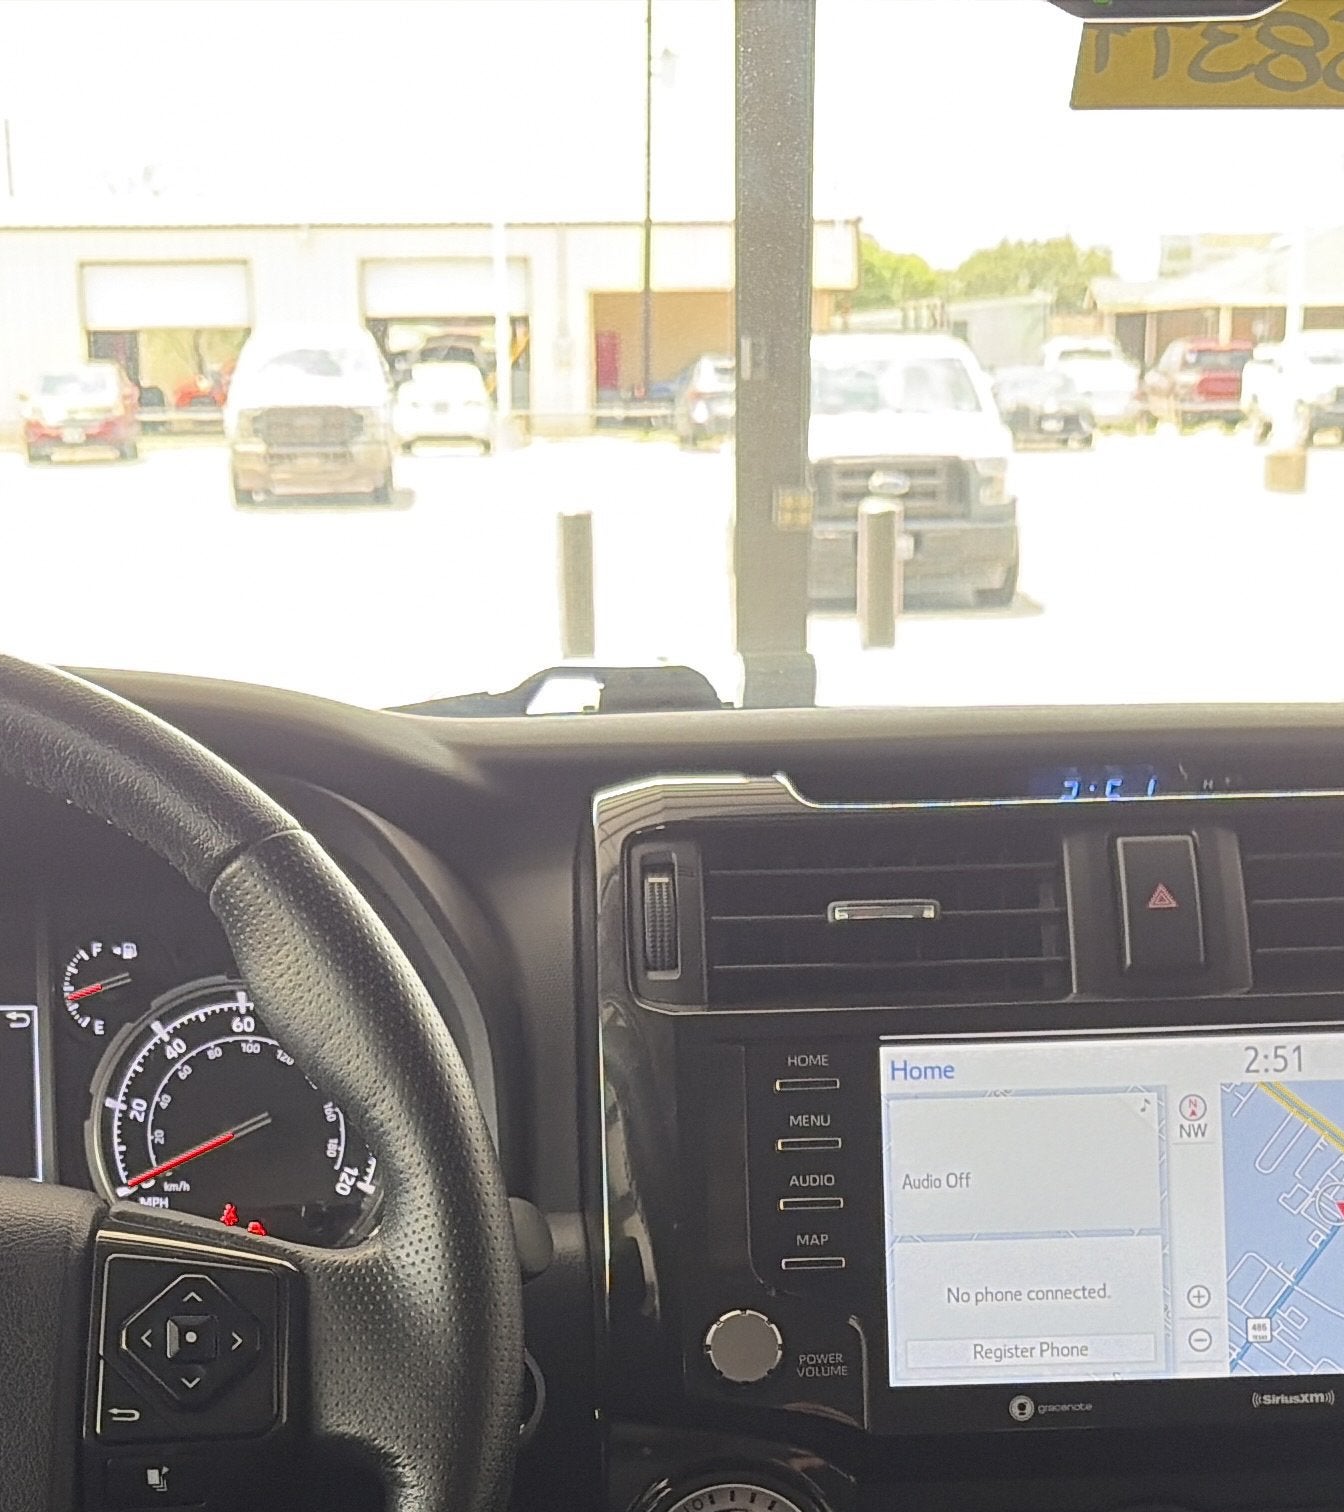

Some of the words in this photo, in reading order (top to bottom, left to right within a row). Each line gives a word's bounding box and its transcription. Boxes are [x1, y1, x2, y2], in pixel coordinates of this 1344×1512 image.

[91, 942, 103, 958] F
[94, 1019, 105, 1035] E
[231, 1016, 255, 1033] 60
[164, 1038, 187, 1060] 40
[207, 1046, 223, 1060] 80
[240, 1041, 261, 1054] 100
[275, 1048, 295, 1066] 120
[787, 1054, 830, 1067] HOME
[1243, 1044, 1304, 1074] 2:51
[177, 1064, 193, 1080] 60
[890, 1059, 956, 1081] Home
[159, 1094, 172, 1110] 40
[129, 1098, 148, 1123] 20
[323, 1101, 337, 1123] 160
[789, 1113, 831, 1128] MENU
[154, 1129, 165, 1145] 20
[1178, 1123, 1209, 1139] NW
[163, 1180, 191, 1192] km/h
[335, 1165, 359, 1196] 120
[789, 1173, 836, 1187] AUDIO
[901, 1173, 942, 1190] Audio
[945, 1172, 971, 1189] Off
[796, 1233, 829, 1247] MAP
[946, 1287, 971, 1304] No
[974, 1286, 1023, 1306] phone
[1026, 1283, 1112, 1301] connected.
[799, 1353, 844, 1366] POWER
[972, 1343, 1036, 1363] Register
[1039, 1341, 1089, 1358] Phone
[796, 1366, 848, 1378] VOLUME
[1037, 1401, 1093, 1415] gracenote
